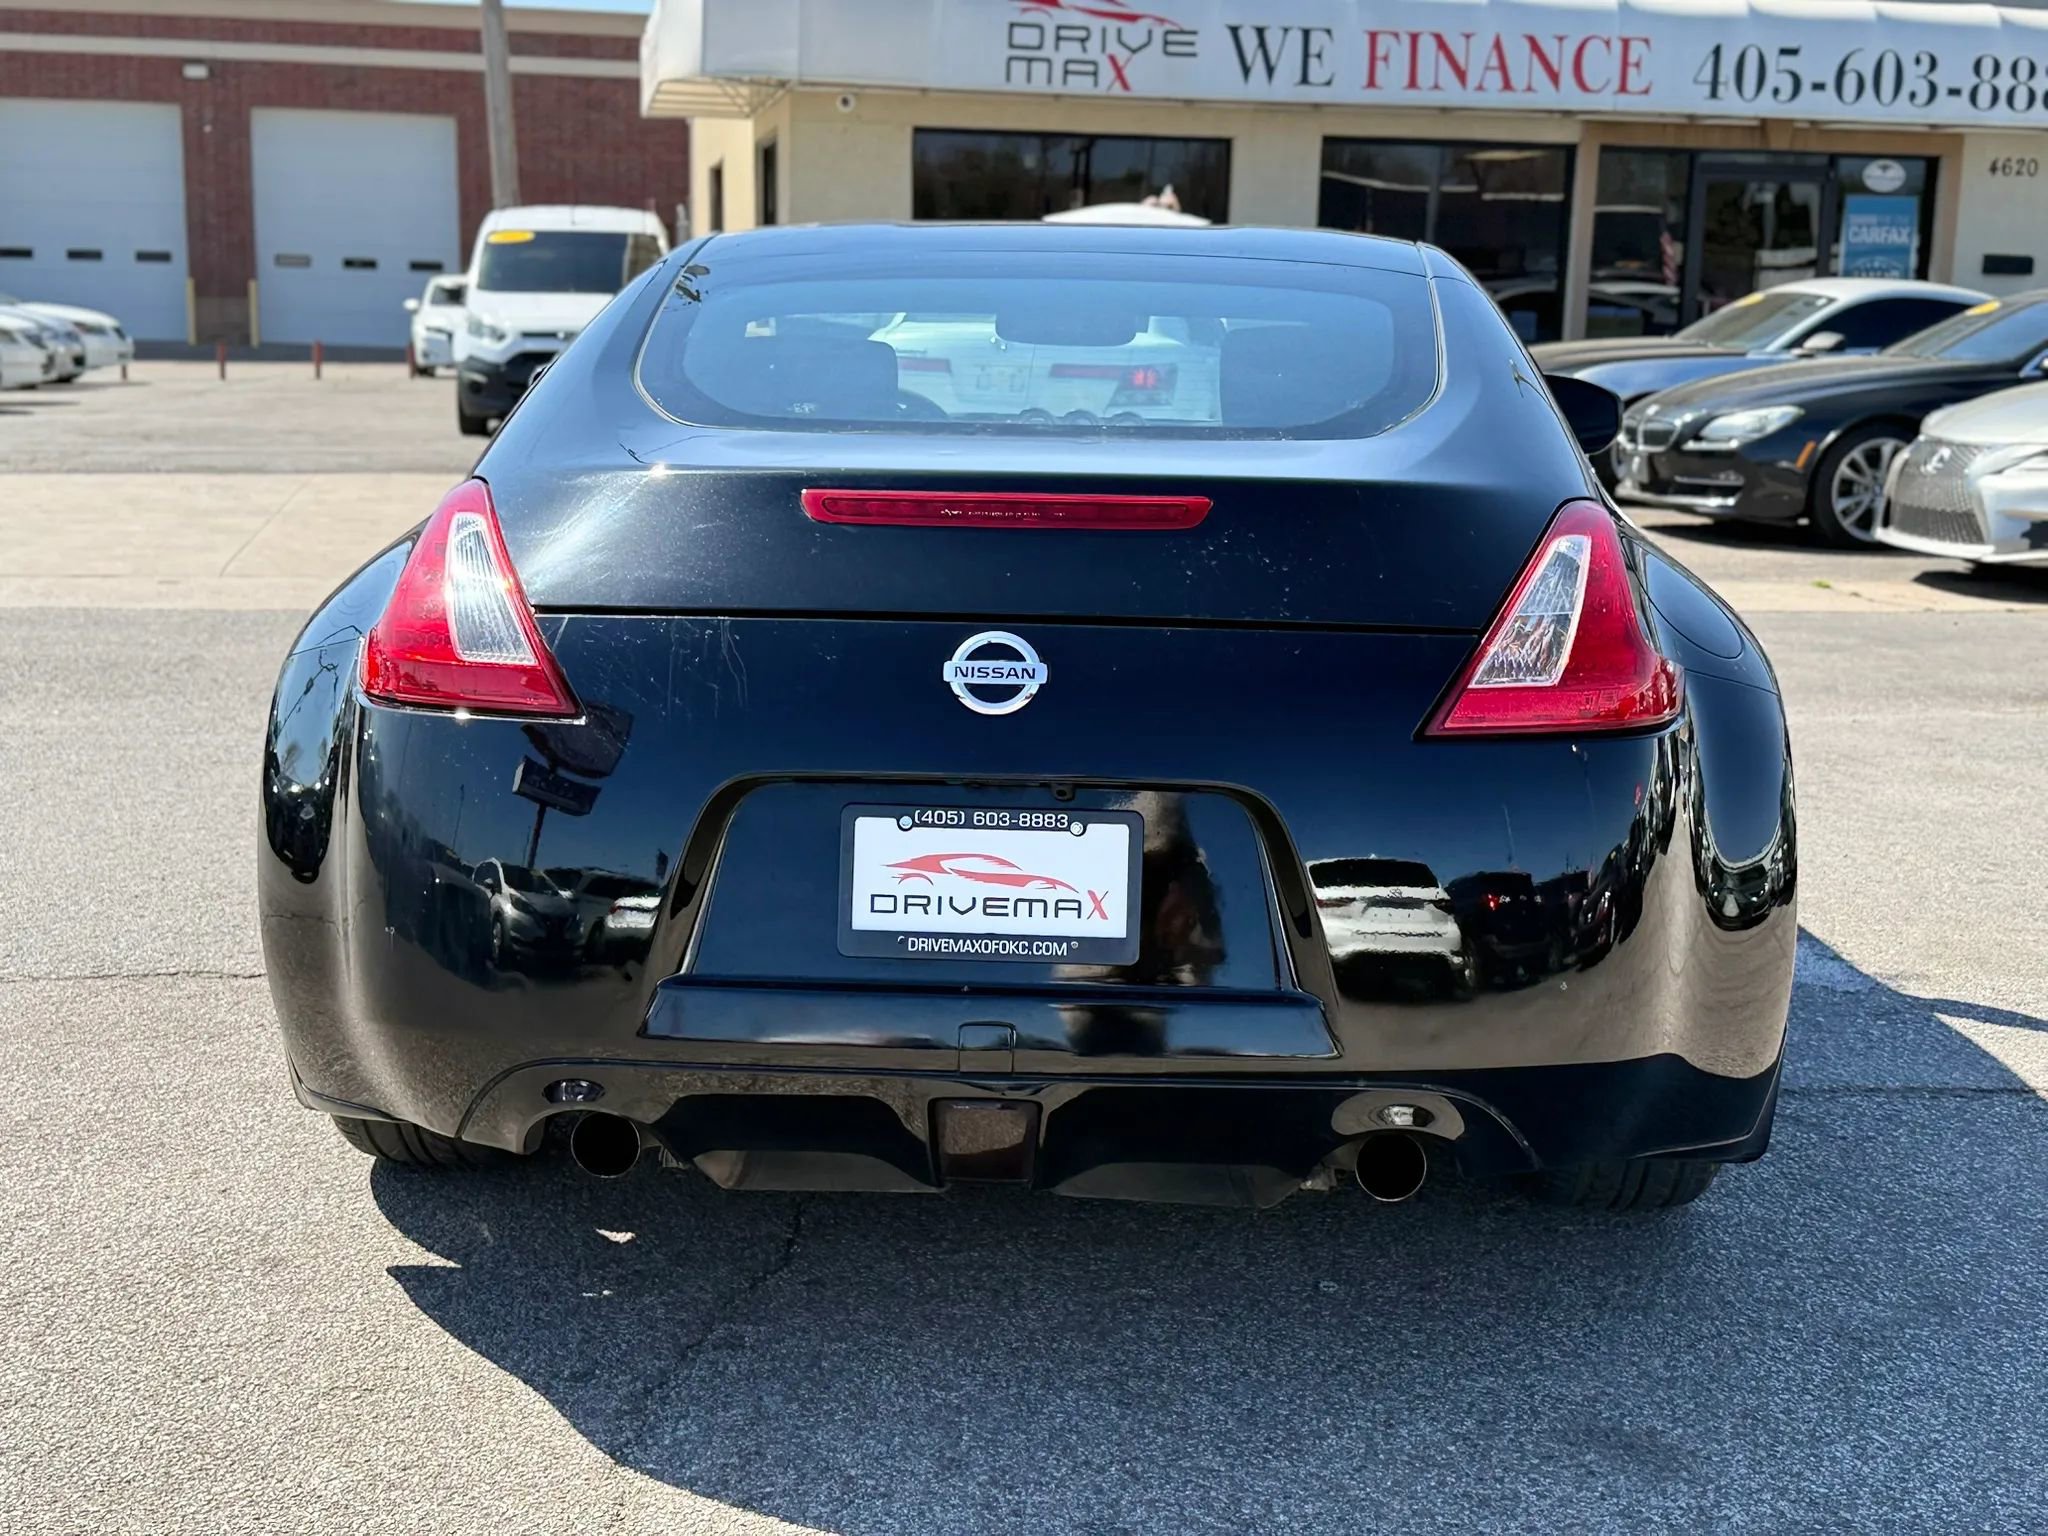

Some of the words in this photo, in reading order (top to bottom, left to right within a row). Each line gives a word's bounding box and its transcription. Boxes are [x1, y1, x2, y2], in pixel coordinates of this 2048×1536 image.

[1008, 22, 1198, 57] DRIVE
[1006, 53, 1131, 92] MAX
[1225, 24, 1335, 86] WE
[1362, 30, 1652, 95] FINANCE
[1692, 42, 2048, 113] 405-603-88
[1989, 157, 2039, 177] 4620
[1849, 226, 1911, 244] CARFAX
[954, 665, 1036, 680] NISSAN
[914, 810, 965, 825] (405)
[973, 812, 1069, 828] 603-8883
[870, 890, 1109, 920] DRIVEMAX
[907, 937, 1068, 956] DRIVEMAXOFOKC.COM
